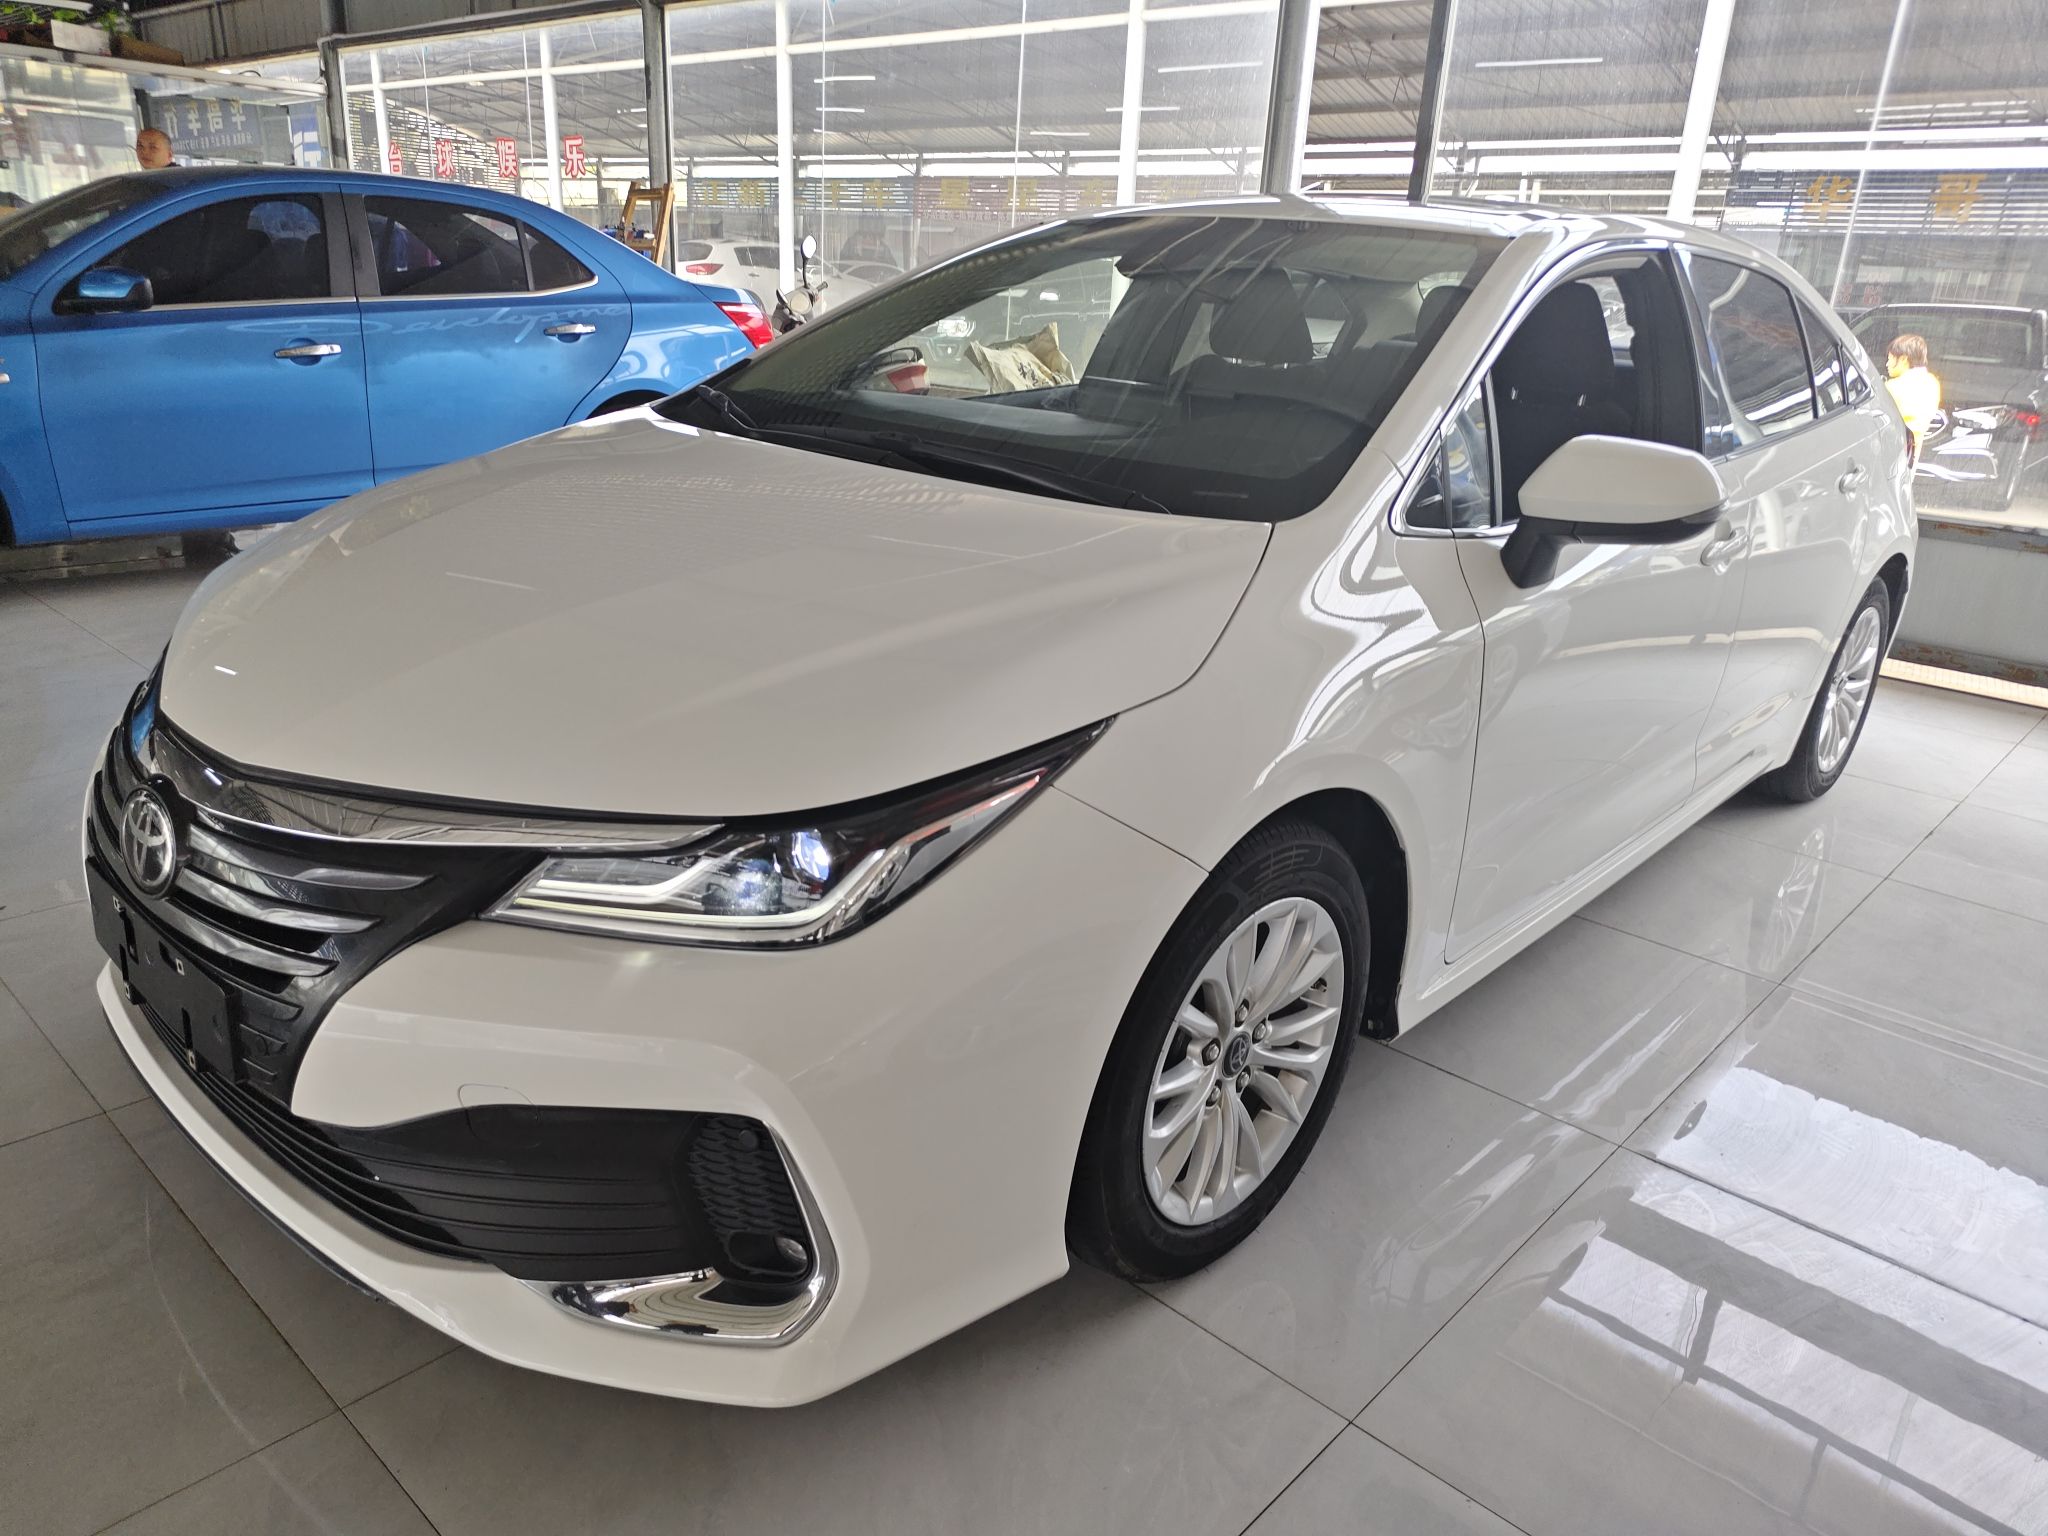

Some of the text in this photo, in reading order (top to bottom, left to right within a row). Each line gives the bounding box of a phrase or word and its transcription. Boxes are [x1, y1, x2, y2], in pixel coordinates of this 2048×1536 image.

[388, 135, 586, 179] 台球娱乐
[1803, 174, 1988, 224] 华哥
